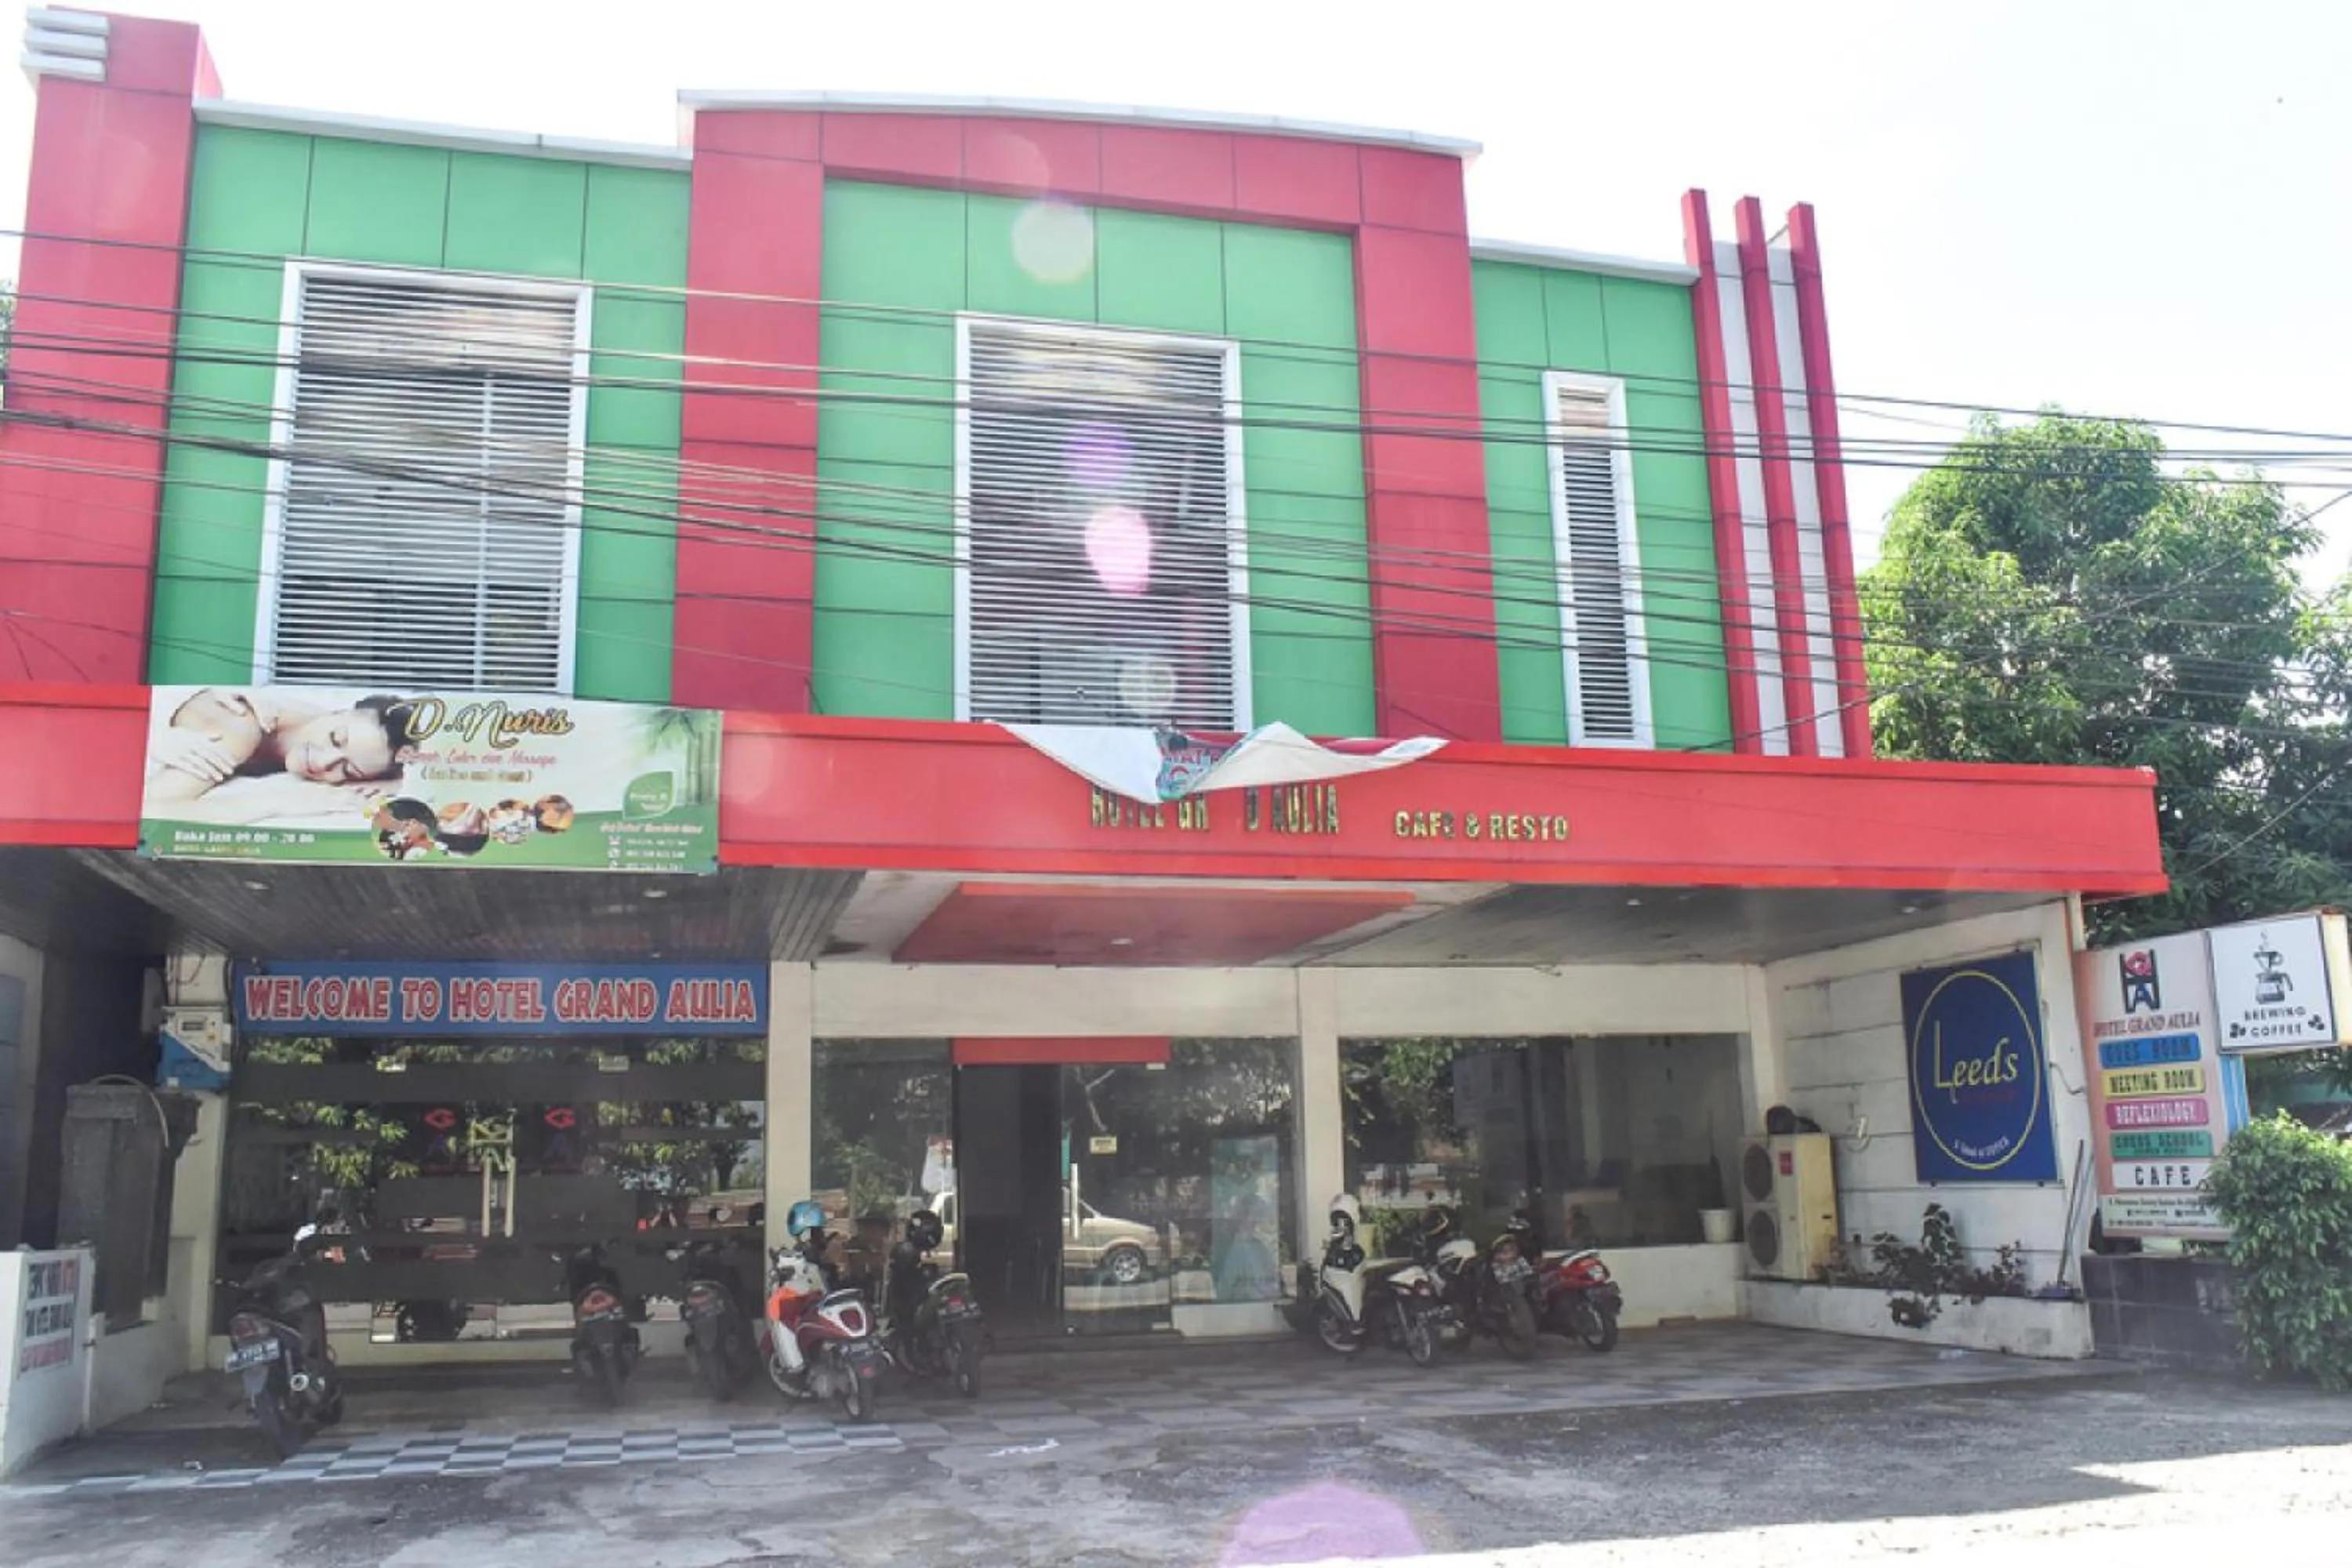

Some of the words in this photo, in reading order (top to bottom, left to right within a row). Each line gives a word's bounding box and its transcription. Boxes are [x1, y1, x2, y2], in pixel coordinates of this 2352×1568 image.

[1490, 813, 1568, 842] RESTO
[244, 975, 391, 1021] WELCOME
[400, 977, 441, 1022] TO
[450, 977, 546, 1023] HOTEL
[554, 978, 659, 1023] GRAND
[665, 978, 757, 1023] AULIA
[2245, 1006, 2307, 1021] BREWING
[2251, 1023, 2301, 1037] COFFEE
[1934, 1020, 2019, 1104] Leeds
[2164, 1069, 2195, 1089] ROOM
[2135, 1165, 2191, 1186] CAFE
